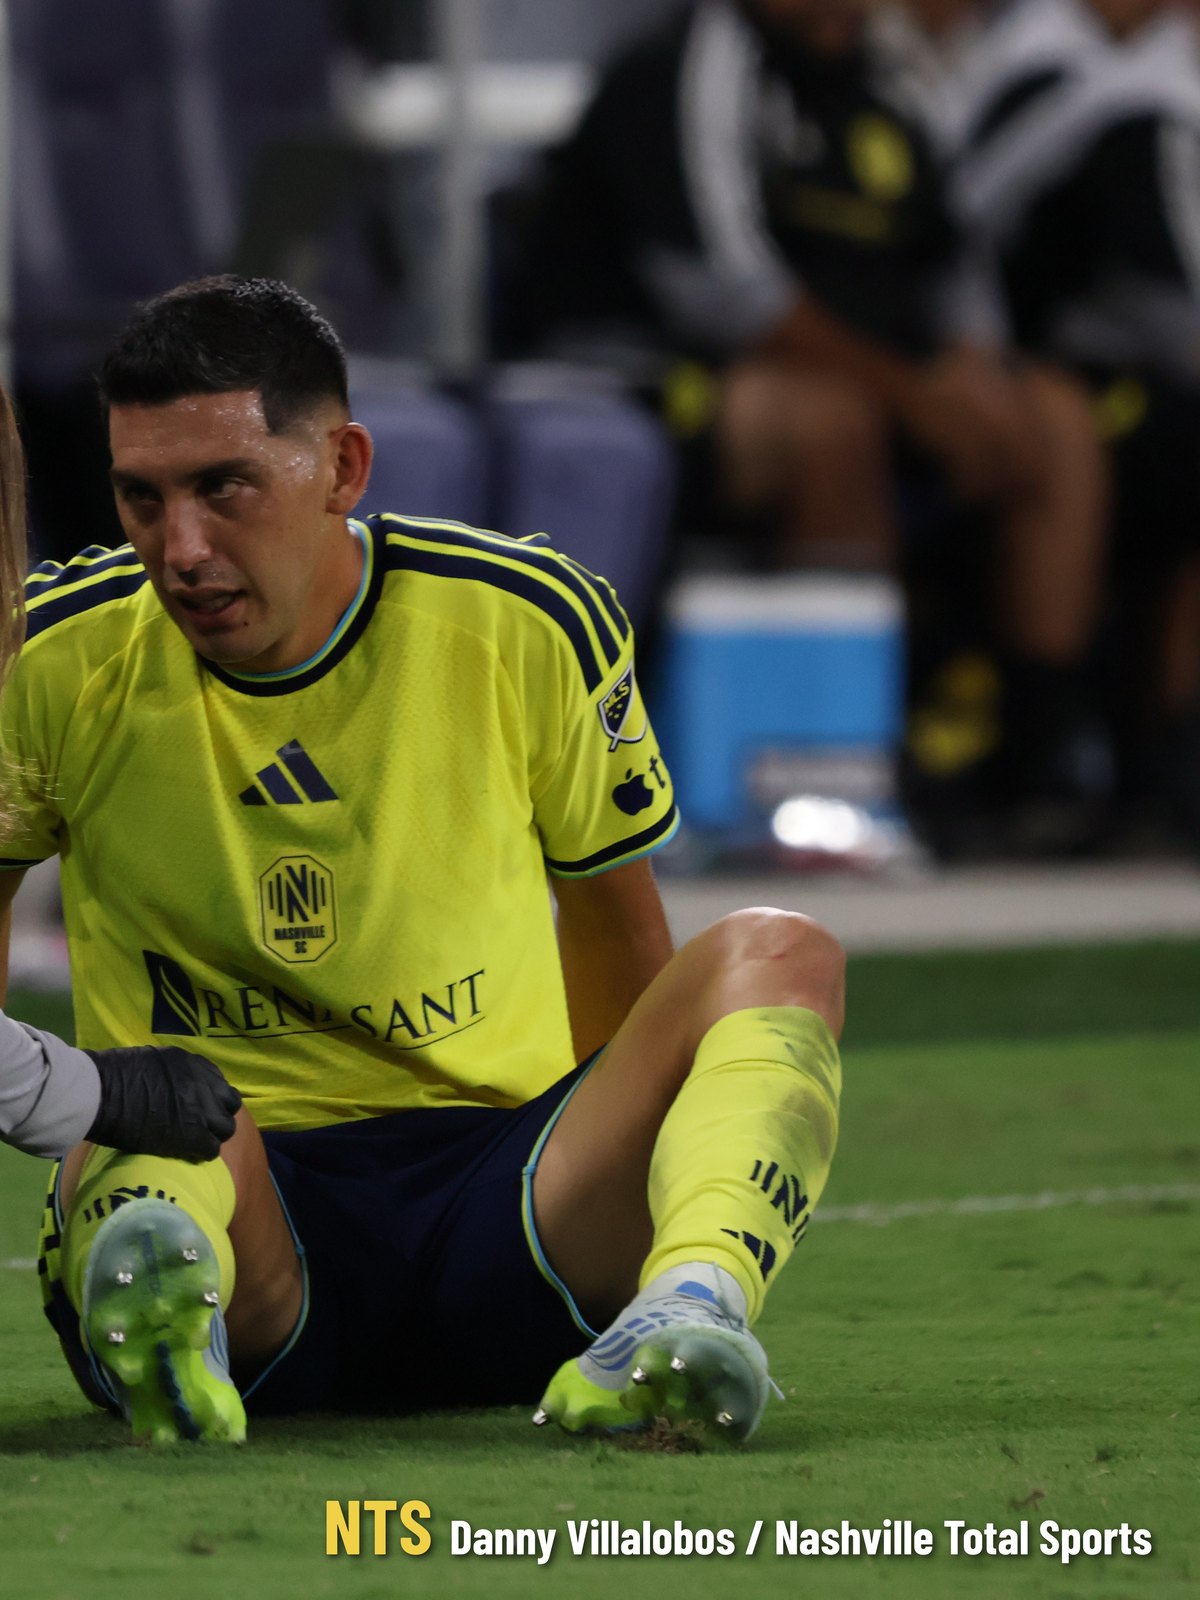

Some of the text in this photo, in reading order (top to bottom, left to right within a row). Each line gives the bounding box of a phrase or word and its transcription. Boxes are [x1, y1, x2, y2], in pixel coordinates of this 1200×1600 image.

[603, 680, 630, 713] MLS
[274, 925, 326, 941] NASHVILLE
[294, 940, 307, 954] SC
[199, 968, 485, 1043] RENSANT
